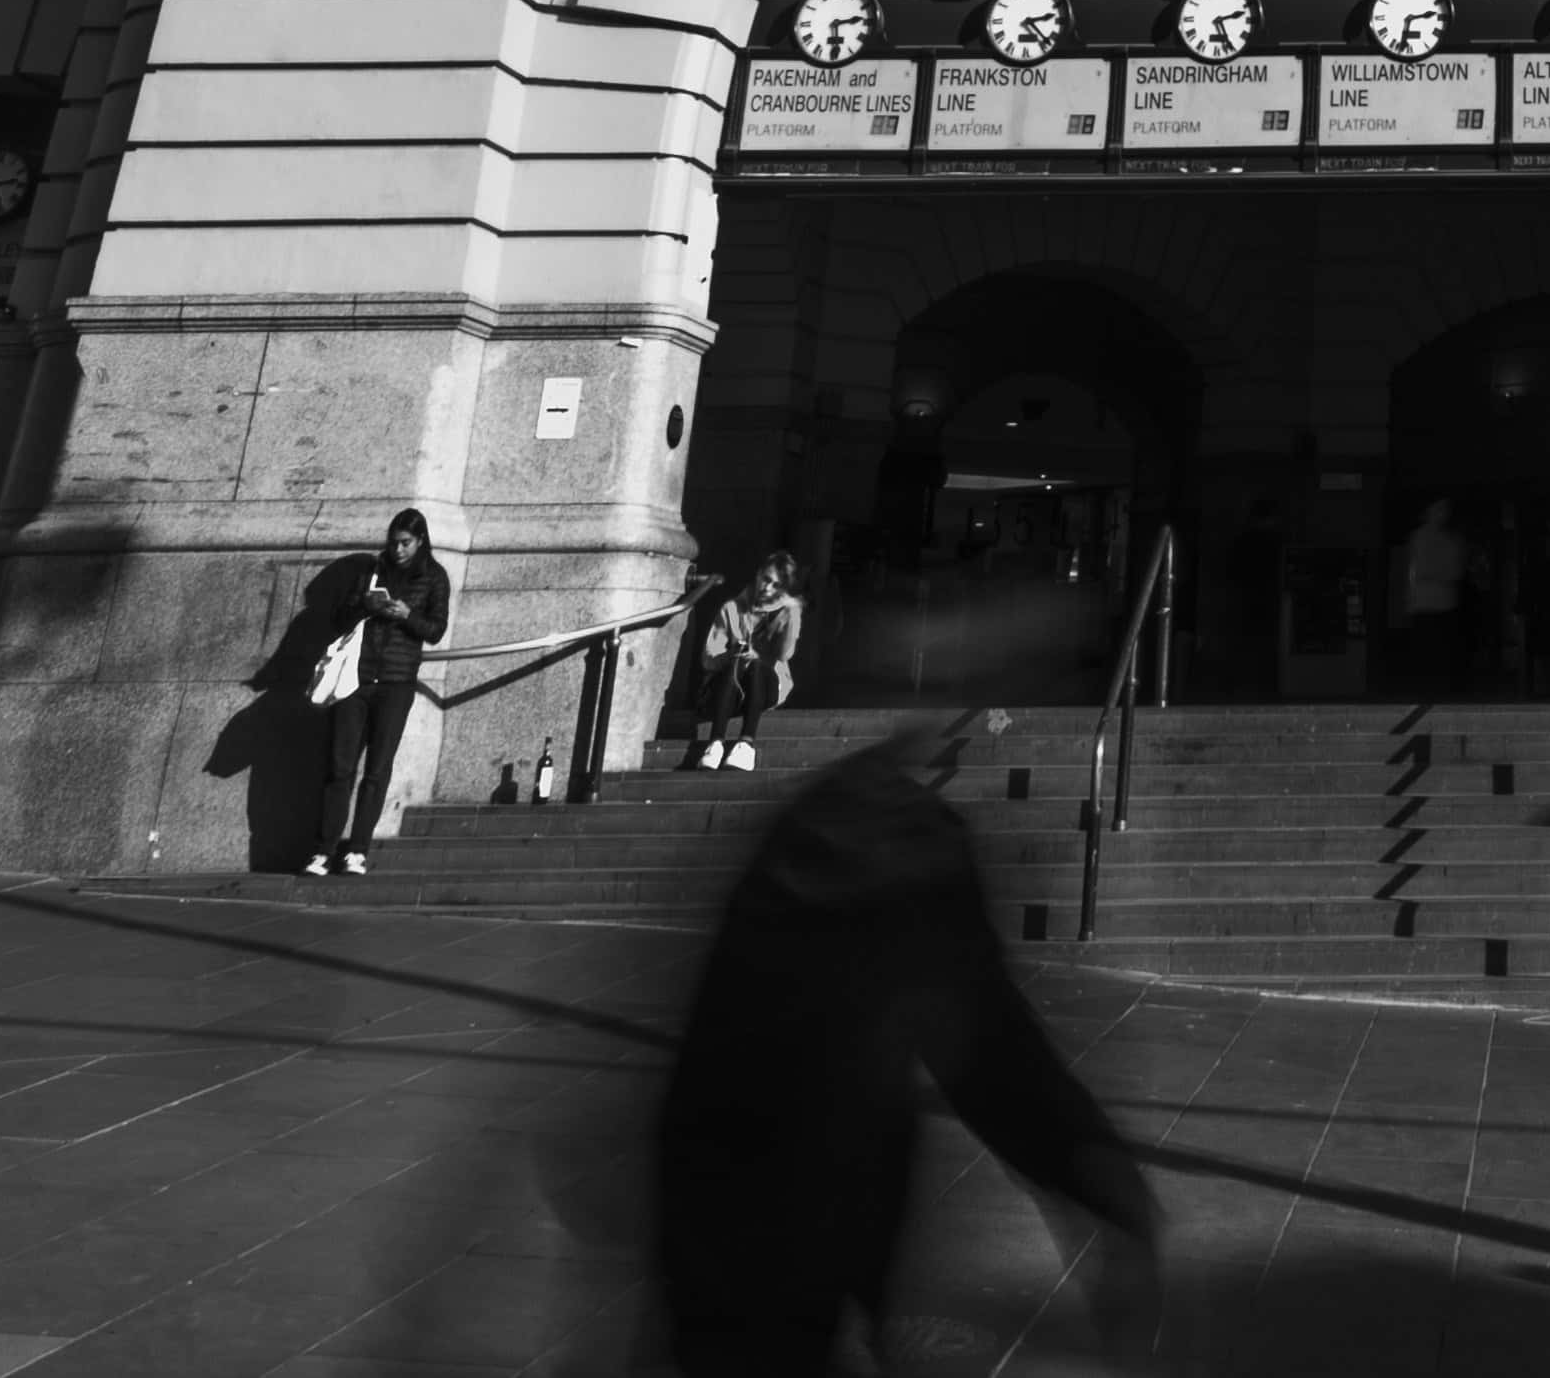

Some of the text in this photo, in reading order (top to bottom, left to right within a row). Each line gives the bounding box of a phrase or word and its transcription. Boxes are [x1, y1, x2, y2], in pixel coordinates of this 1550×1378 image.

[752, 68, 878, 88] PAKENHAM and
[938, 67, 1047, 87] FRANKSTON
[1136, 65, 1268, 84] SANDRINGHAM
[1331, 63, 1469, 83] WILLIAMSTOWN
[750, 94, 912, 113] CRANBOURNE LINES
[936, 94, 976, 113] LINE
[1134, 91, 1173, 110] LINE
[1329, 89, 1369, 108] LINE
[746, 123, 816, 136] PLATFORM
[934, 122, 1003, 136] PLATFORM
[1132, 121, 1202, 134] PLATFORM
[1328, 118, 1397, 132] PLATFORM
